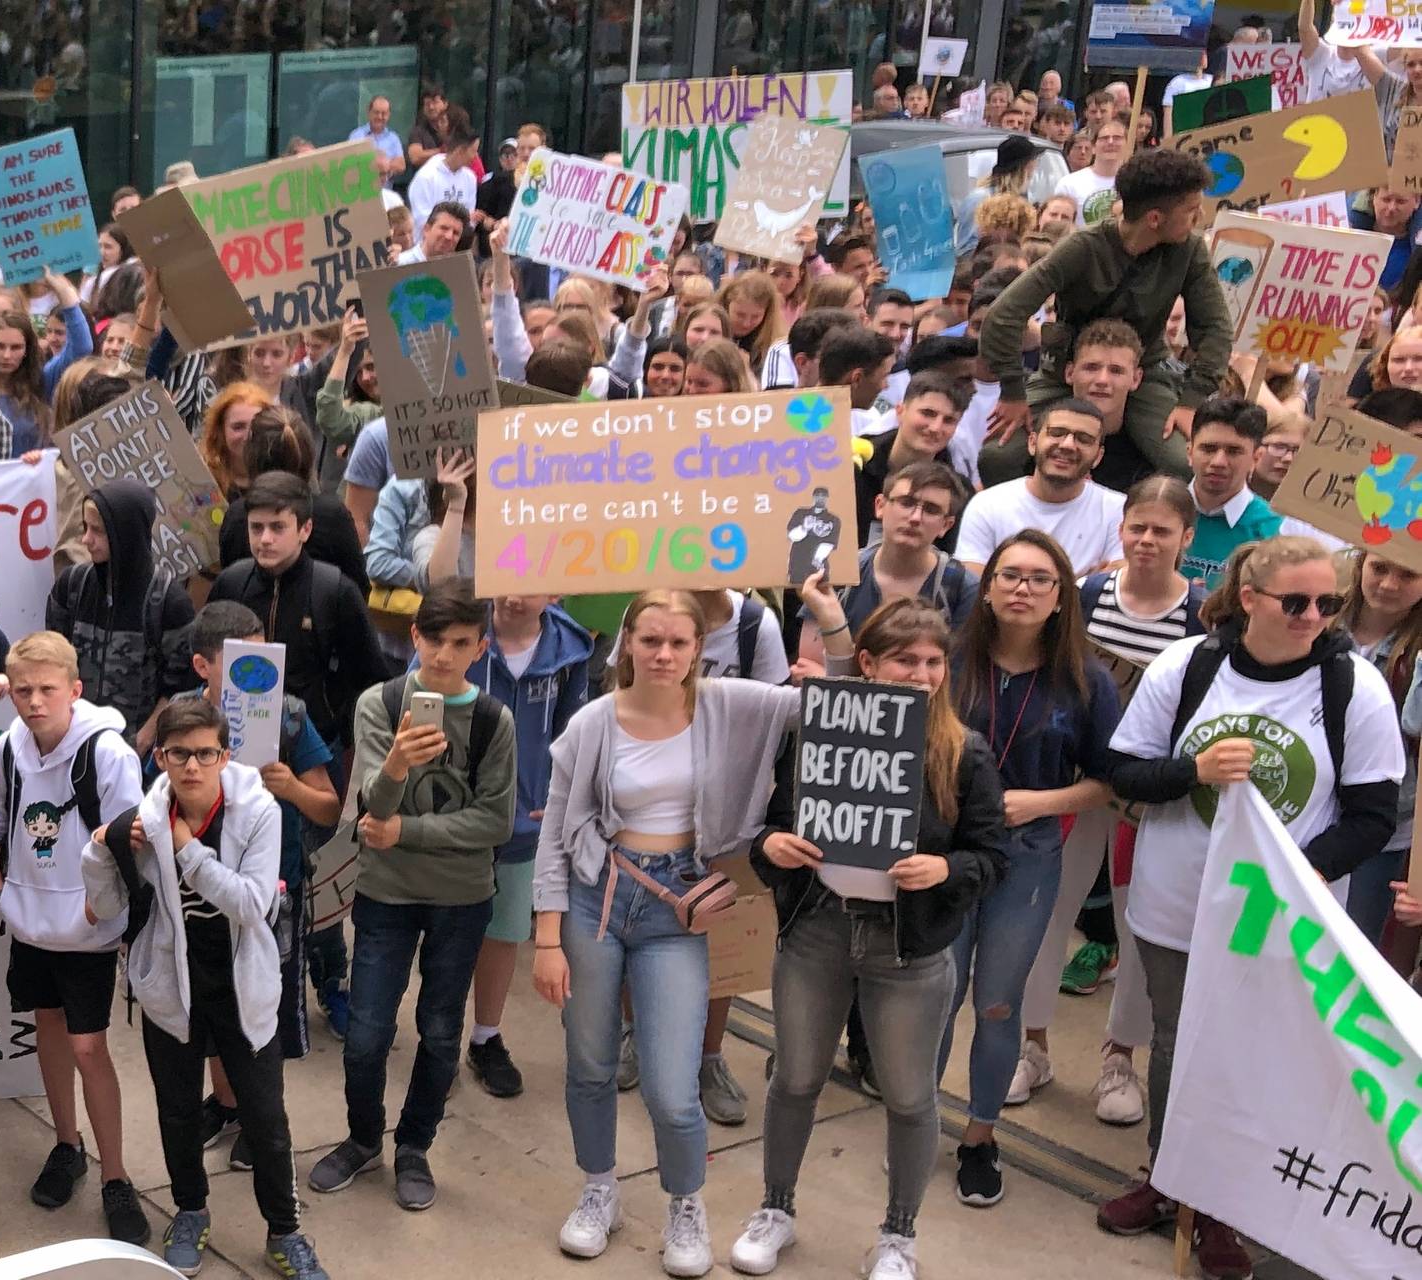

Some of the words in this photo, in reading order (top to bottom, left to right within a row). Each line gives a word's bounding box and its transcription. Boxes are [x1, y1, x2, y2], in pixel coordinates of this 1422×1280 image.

[645, 78, 694, 126] WIR
[702, 72, 807, 125] WOLLEN
[4, 153, 23, 171] AM
[29, 141, 64, 164] SURE
[10, 170, 35, 188] THE
[59, 194, 88, 213] THEY
[606, 173, 667, 228] CLASS
[2, 230, 35, 249] HAD
[41, 214, 83, 238] TIME
[220, 222, 305, 284] ORSE
[323, 208, 353, 248] IS
[596, 230, 645, 277] ASS
[1280, 243, 1344, 285] TIME
[1343, 253, 1380, 289] IS
[1256, 284, 1369, 331] RUNNING
[1266, 324, 1324, 358] OUT
[69, 421, 100, 462] AT
[102, 388, 159, 434] THIS
[394, 401, 427, 421] IT'S
[432, 396, 453, 414] SO
[456, 388, 490, 408] HOT
[501, 411, 525, 441] if
[533, 416, 580, 440] we
[592, 402, 677, 438] don't
[695, 400, 774, 436] stop
[80, 428, 150, 486] POINT
[157, 418, 171, 442] I
[398, 424, 421, 447] MY
[403, 453, 420, 470] IS
[488, 440, 656, 491] climate
[672, 431, 843, 494] change
[501, 499, 588, 526] there
[604, 492, 684, 521] can't
[700, 488, 739, 517] be
[754, 494, 772, 515] a
[496, 522, 748, 580] 4/20/69
[805, 684, 915, 738] PLANET
[1184, 716, 1250, 757] RIDAYS
[1255, 718, 1295, 751] FOR
[800, 741, 915, 794] BEFORE
[797, 797, 915, 851] PROFIT.
